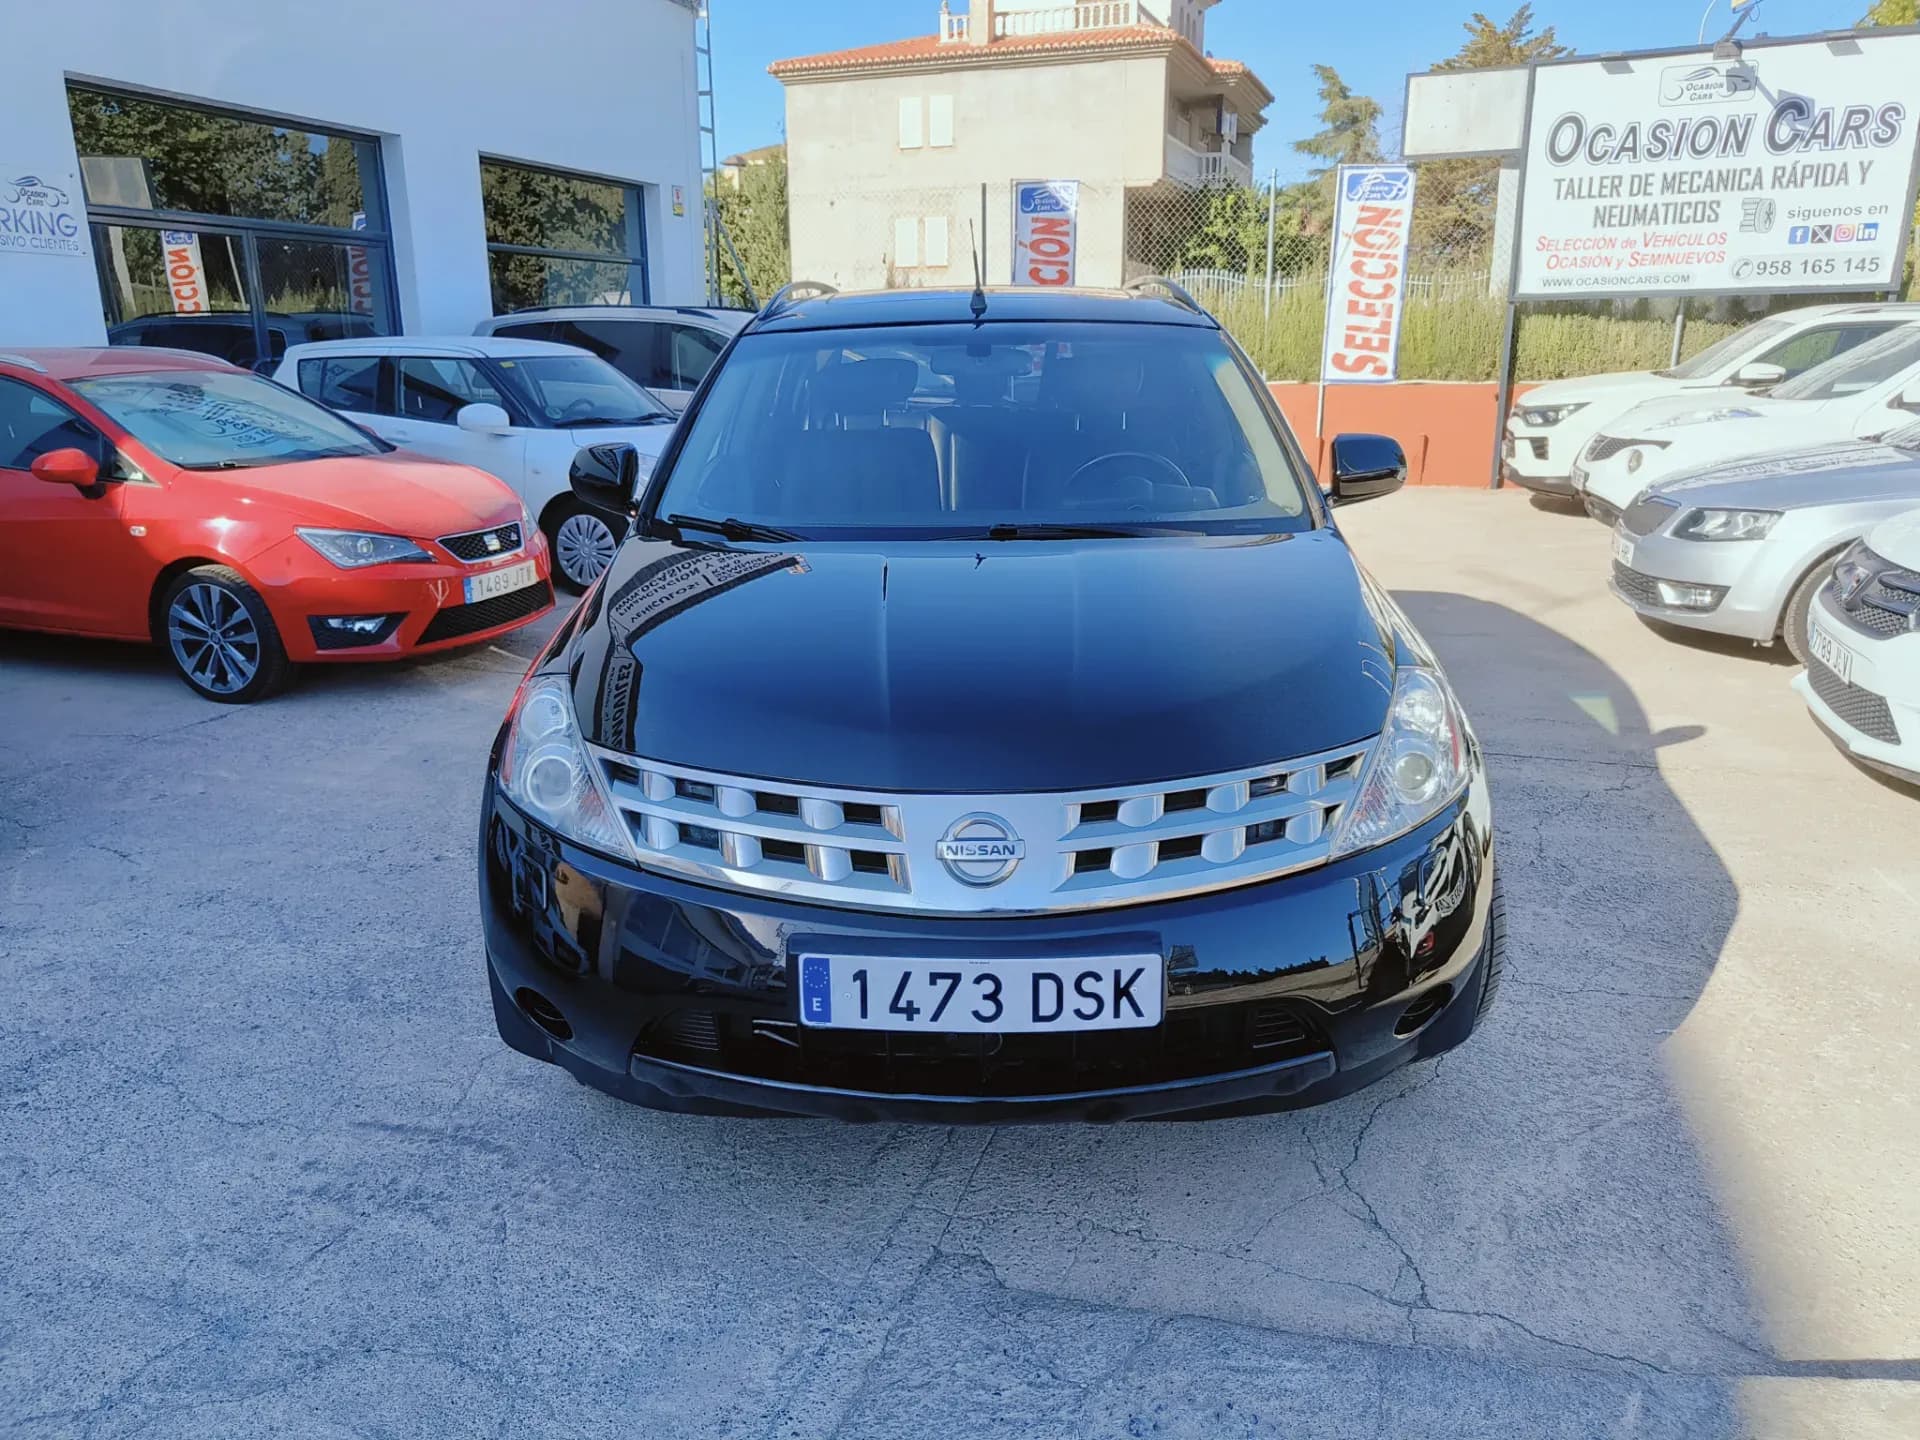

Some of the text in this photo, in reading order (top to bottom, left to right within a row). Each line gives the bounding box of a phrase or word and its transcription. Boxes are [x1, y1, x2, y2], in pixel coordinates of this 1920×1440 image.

[1545, 97, 1905, 167] OCASION CARS
[1553, 160, 1875, 201] TALLER DE MECANICA RÁPIDA Y
[1592, 200, 1721, 229] NEUMATICOS
[1786, 204, 1889, 222] siguenos en
[30, 237, 79, 251] CLIENTES
[1536, 231, 1728, 252] SELECCIÓN de VEHÍCULOS
[1546, 254, 1612, 270] OCASIÓN
[1628, 250, 1726, 268] SEMINUEVOS
[1756, 257, 1881, 276] 958 165 145
[1331, 204, 1404, 377] SELECCIÓN
[1542, 274, 1690, 287] WWW.OCASIONCARS.COM
[946, 844, 1016, 857] NISSAN
[812, 997, 822, 1011] E
[852, 967, 1146, 1023] 1473 DSK
